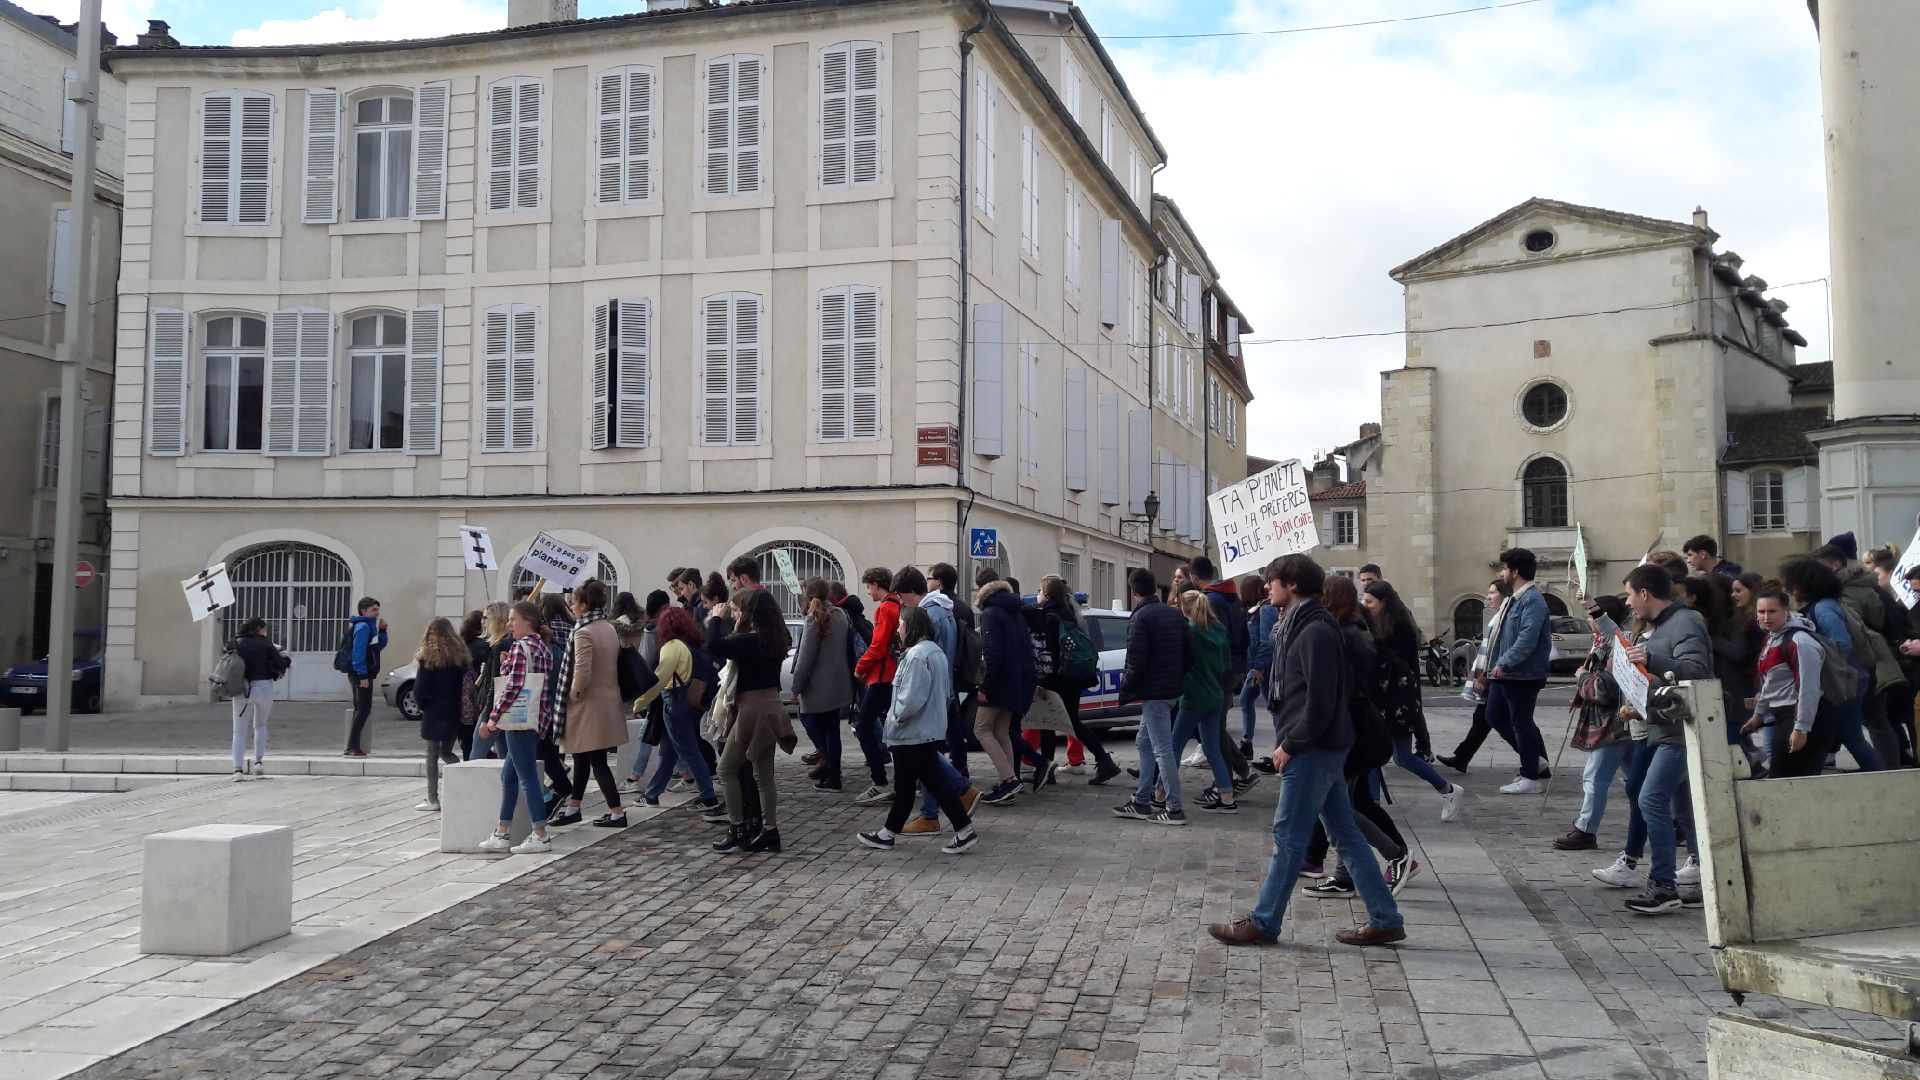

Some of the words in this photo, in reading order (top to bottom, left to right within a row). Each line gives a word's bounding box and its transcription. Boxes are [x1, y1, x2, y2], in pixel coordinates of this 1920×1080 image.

[1216, 489, 1244, 515] TA
[1220, 521, 1238, 537] TU
[562, 550, 576, 560] pas
[576, 556, 585, 565] de
[1221, 526, 1264, 563] BLEUE
[531, 549, 567, 570] planète
[569, 566, 579, 575] B
